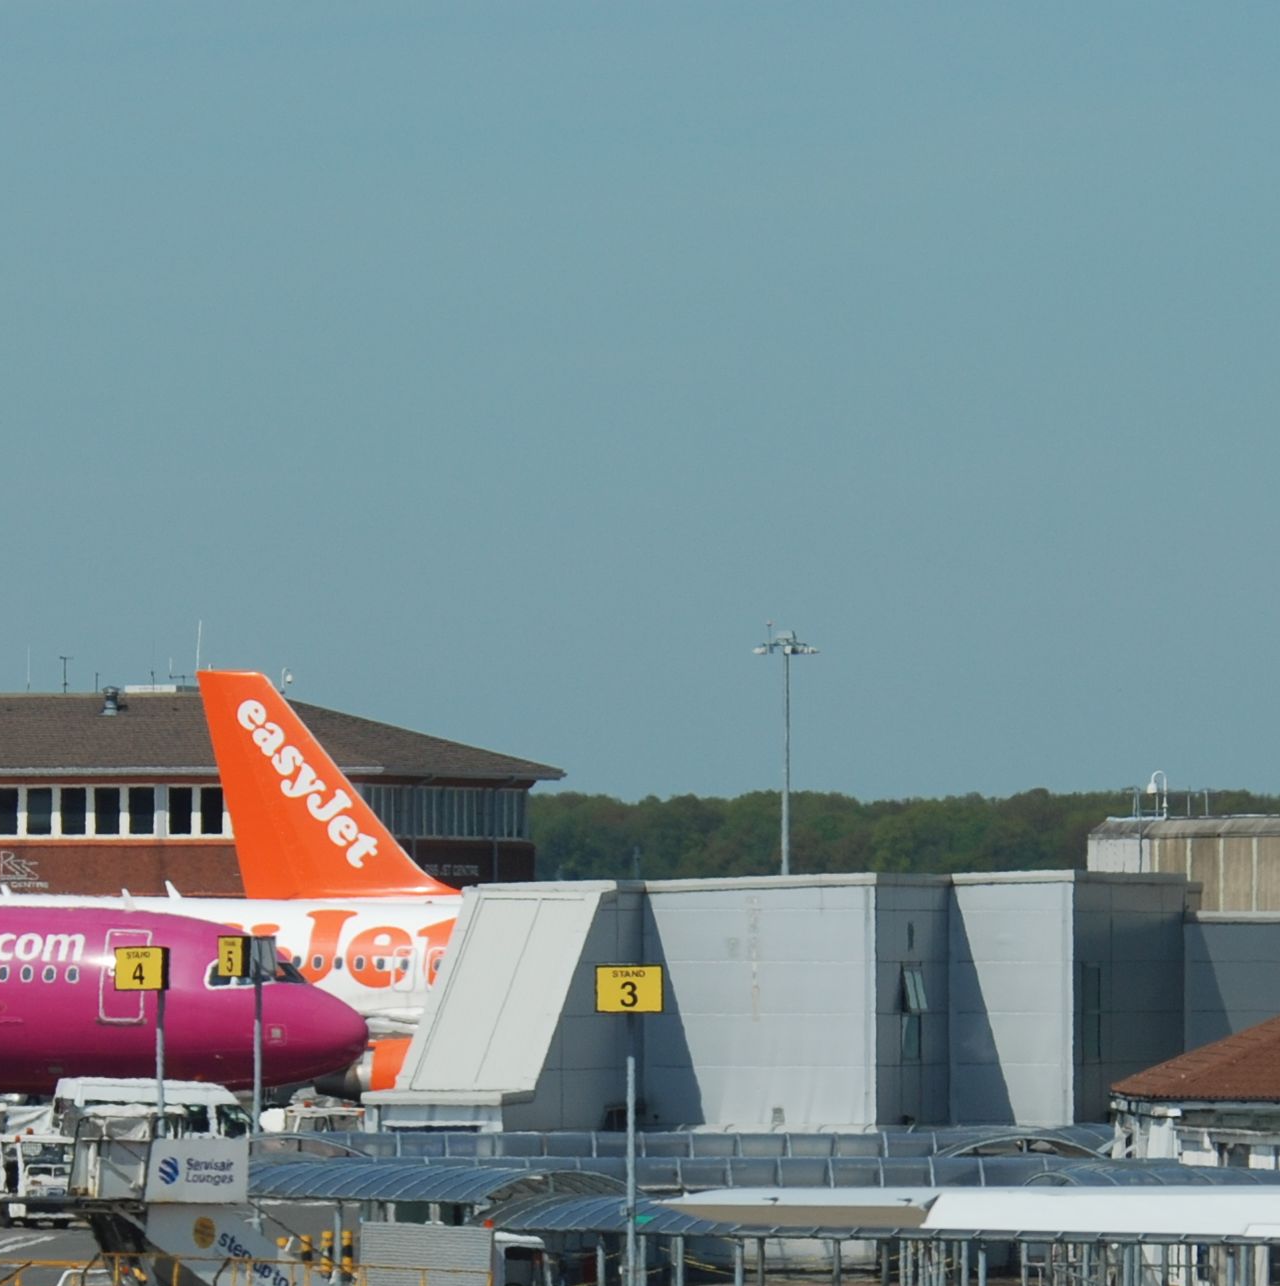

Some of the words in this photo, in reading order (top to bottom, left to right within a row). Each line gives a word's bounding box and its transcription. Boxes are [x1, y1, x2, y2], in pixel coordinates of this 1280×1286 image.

[236, 699, 378, 869] easyJet
[226, 951, 234, 973] 5
[132, 962, 145, 985] 4
[612, 970, 646, 978] STAND
[620, 981, 639, 1008] 3
[186, 1158, 235, 1171] Servisair
[185, 1171, 235, 1186] Lounges
